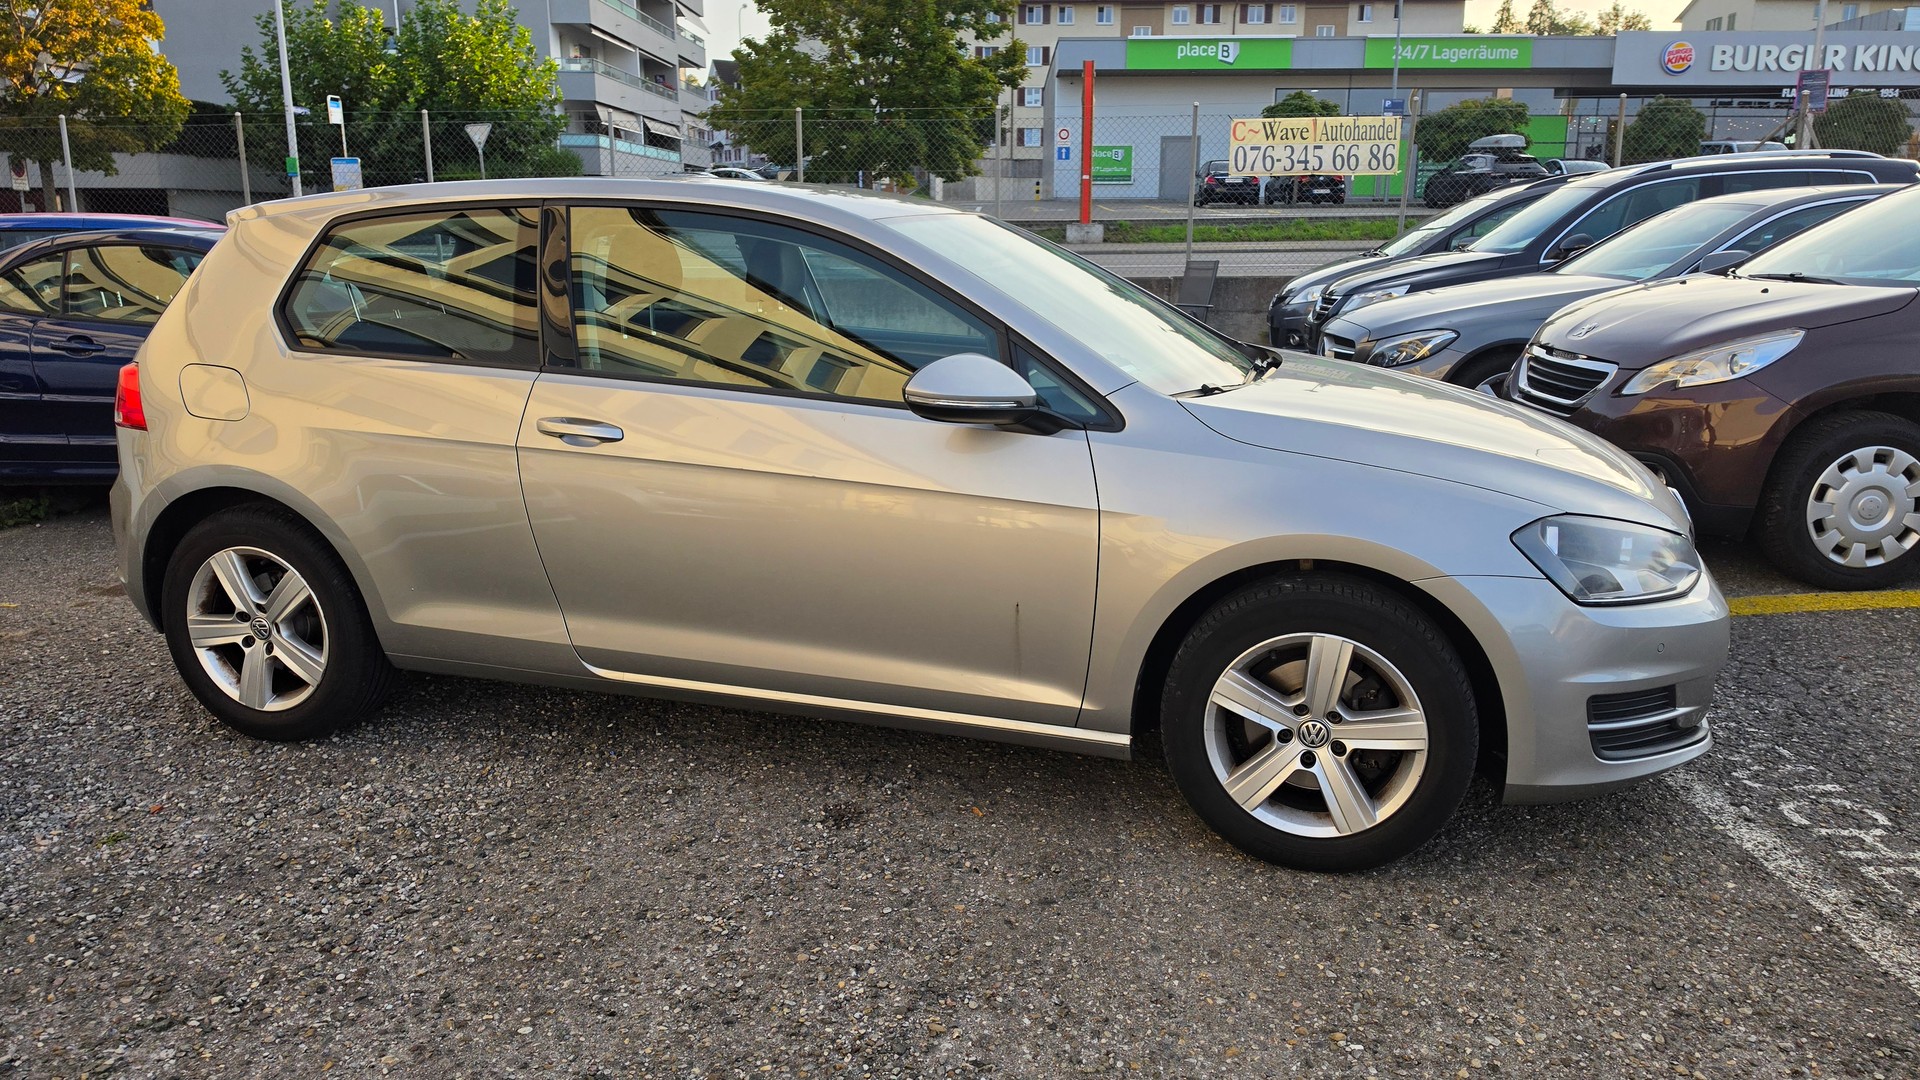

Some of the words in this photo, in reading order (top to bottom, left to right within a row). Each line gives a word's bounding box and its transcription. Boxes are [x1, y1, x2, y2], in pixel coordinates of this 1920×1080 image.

[1392, 45, 1429, 60] 24/7
[1432, 45, 1519, 62] Lagerräume
[1667, 54, 1692, 65] KING
[1853, 44, 1920, 71] KIN
[1880, 88, 1900, 98] 1954
[1319, 118, 1398, 141] Autohandel
[1234, 145, 1323, 172] 076-345
[1332, 144, 1360, 171] 66
[1368, 143, 1395, 171] 86
